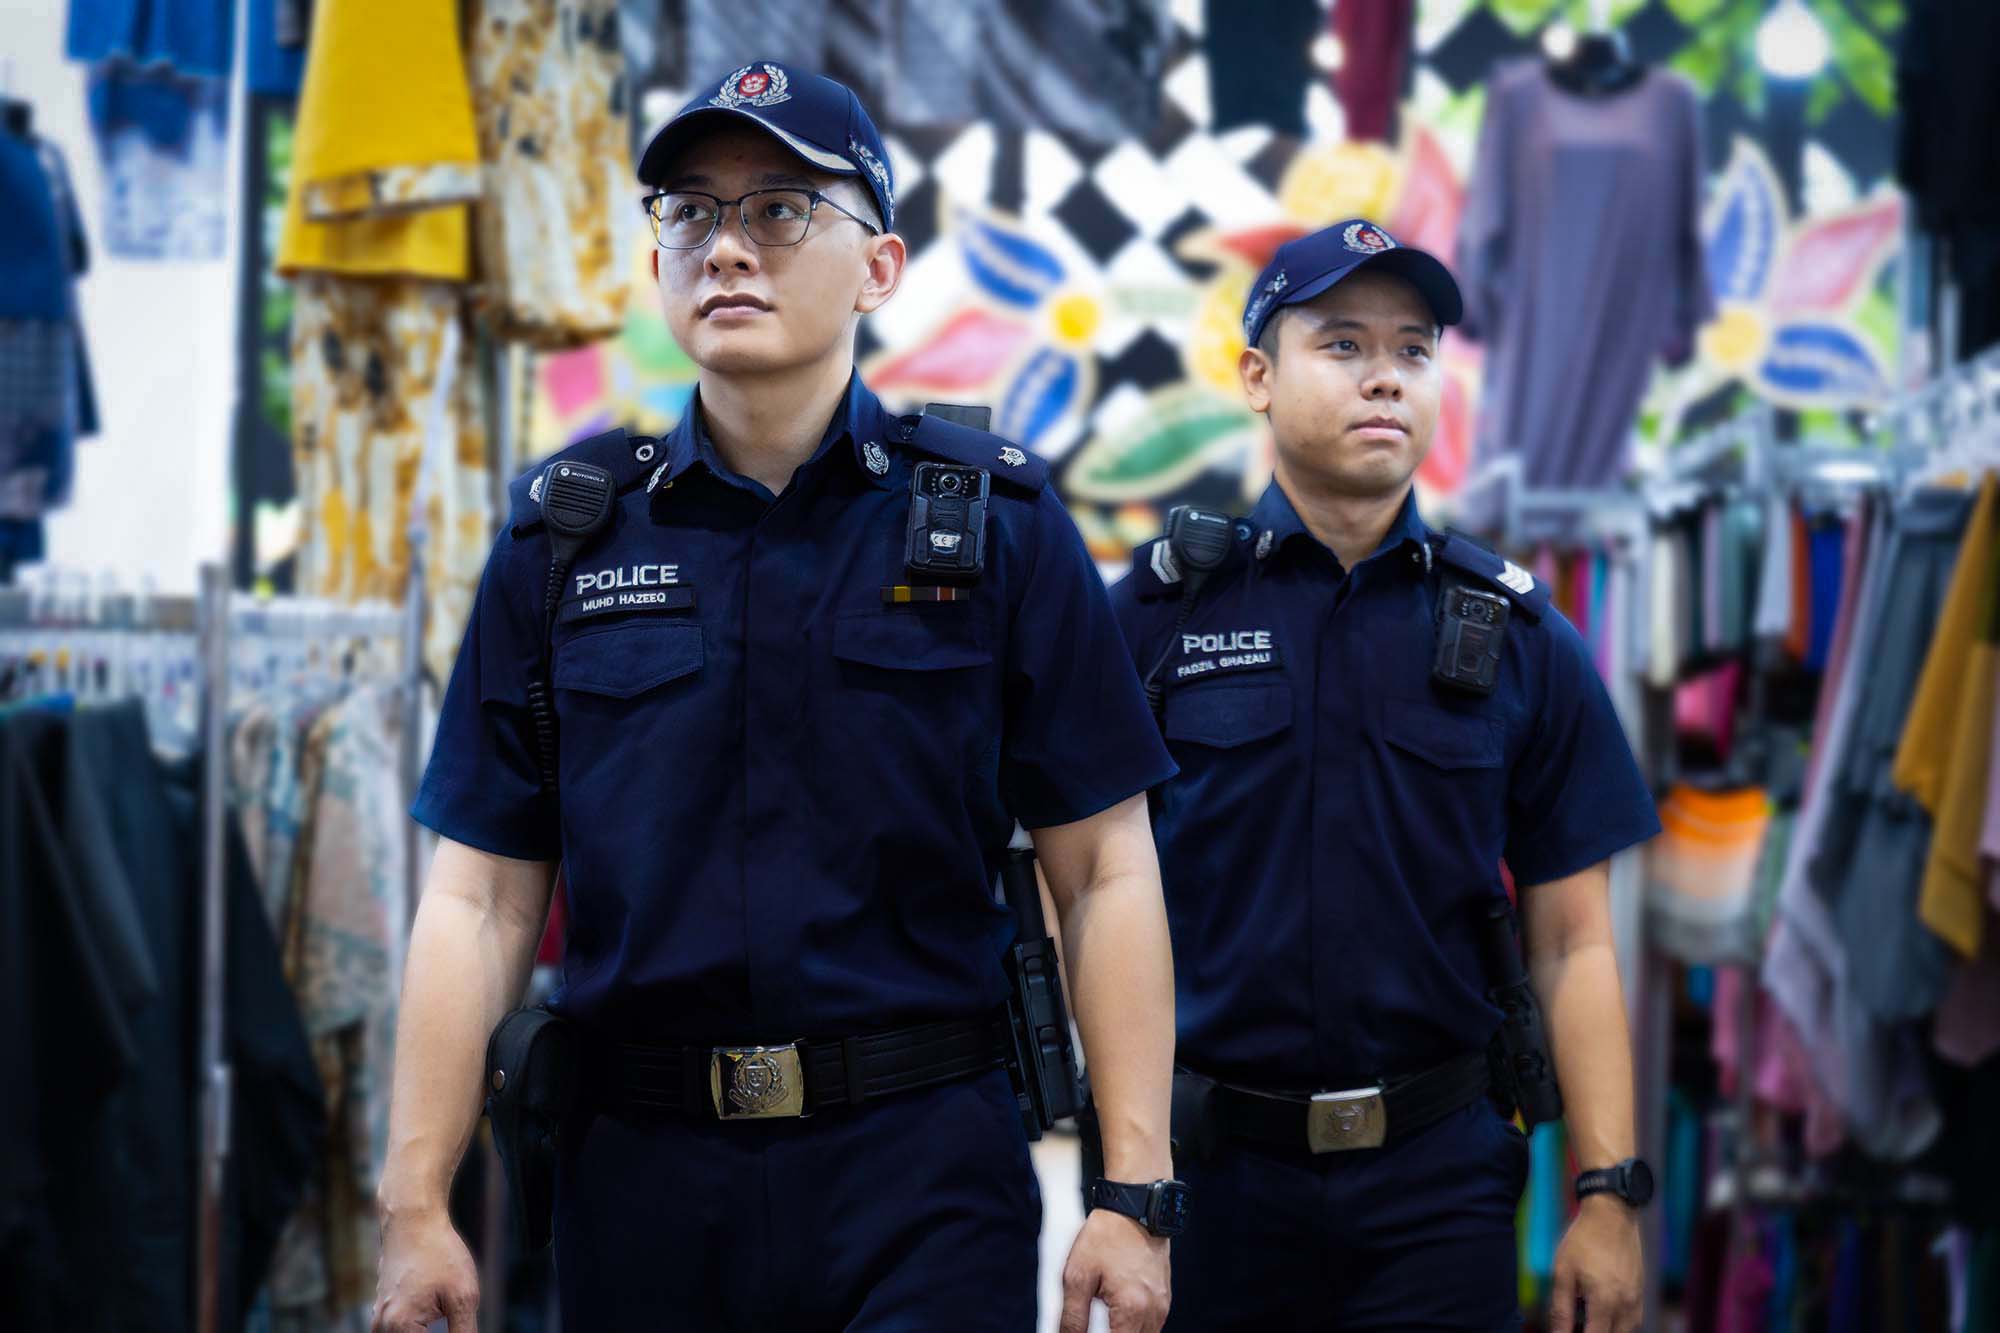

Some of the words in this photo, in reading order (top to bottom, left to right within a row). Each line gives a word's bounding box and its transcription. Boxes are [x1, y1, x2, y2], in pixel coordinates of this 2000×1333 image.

[571, 471, 605, 482] MOTOROLA
[576, 564, 679, 595] POLICE
[583, 597, 614, 612] MUHD
[619, 592, 666, 605] HAZEEQ
[1182, 630, 1272, 654] POLICE
[1177, 660, 1216, 677] FADZIL
[1219, 652, 1270, 667] GHAZALI
